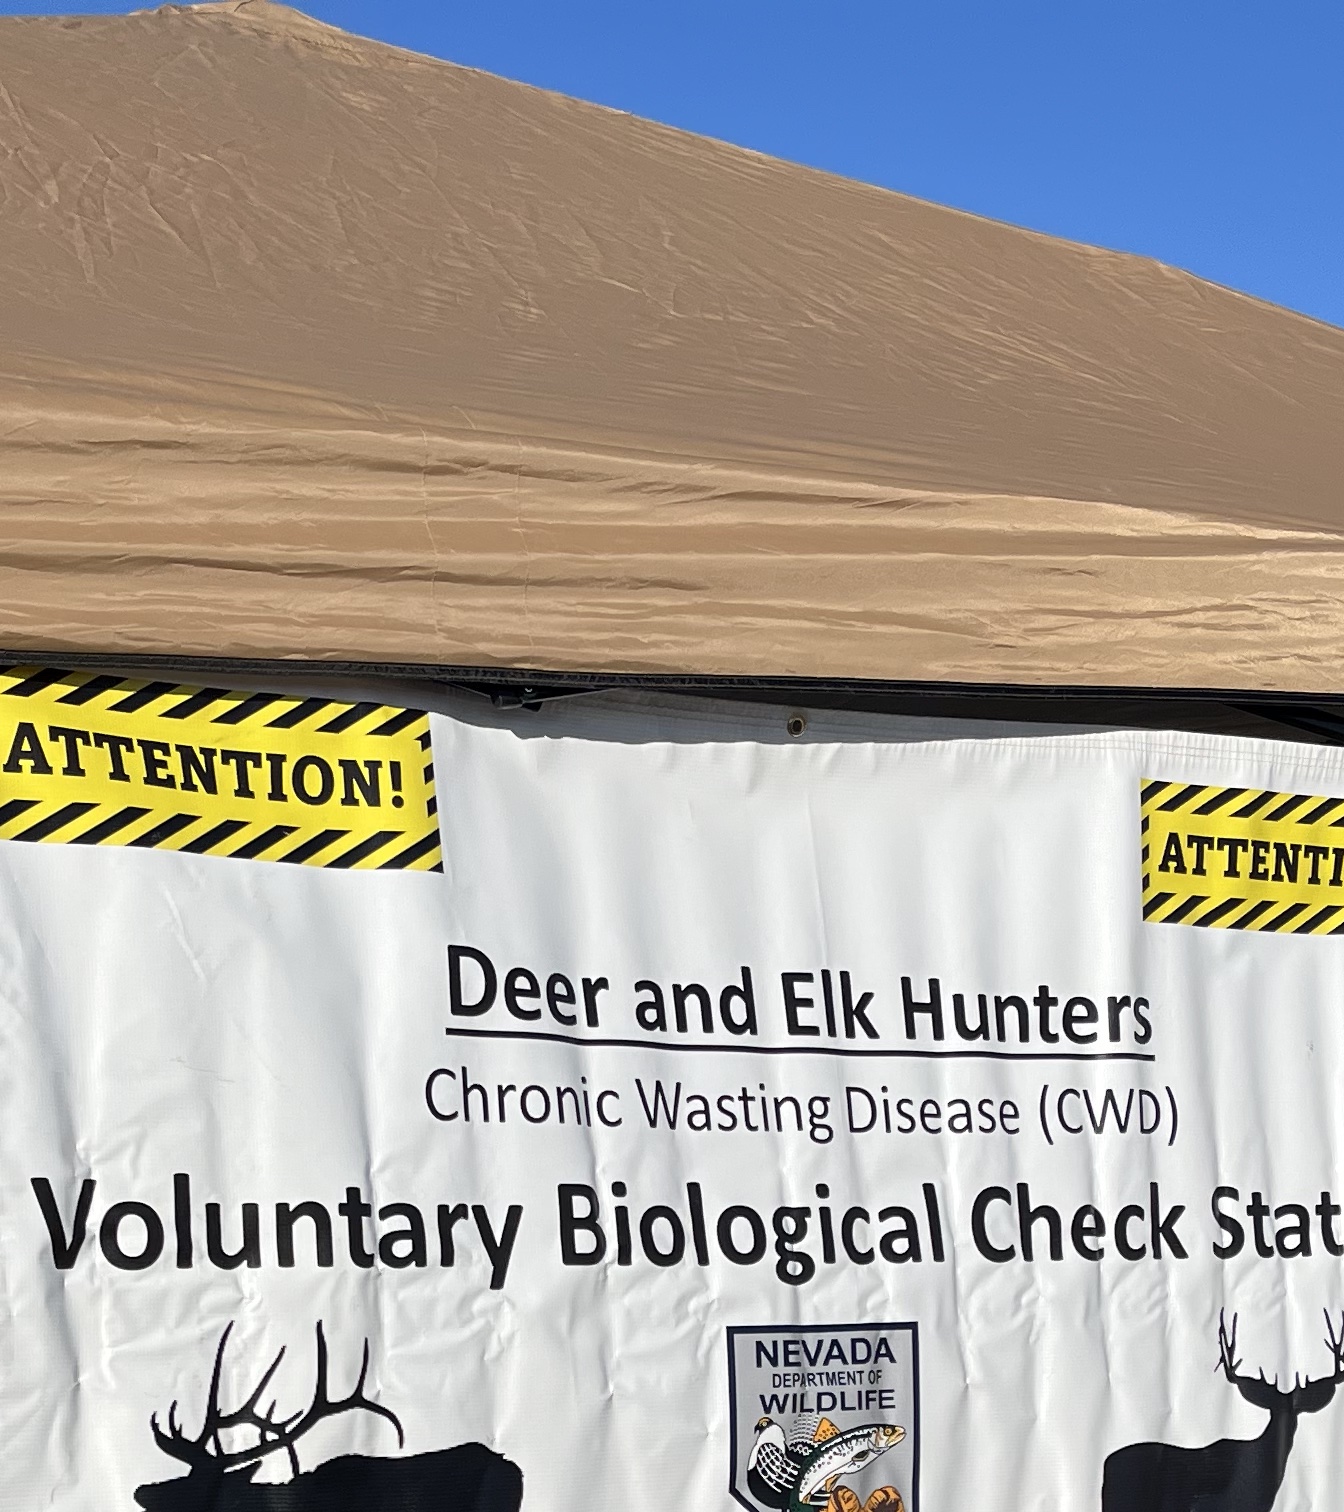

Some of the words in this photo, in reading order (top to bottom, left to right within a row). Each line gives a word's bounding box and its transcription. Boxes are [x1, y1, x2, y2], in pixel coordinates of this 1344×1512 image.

[2, 722, 405, 809] ATTENTION!
[447, 944, 610, 1028] Deer
[634, 965, 758, 1036] and
[781, 968, 881, 1040] Elk
[900, 976, 1153, 1045] Hunters
[425, 1065, 623, 1128] Chronic
[634, 1077, 834, 1145] Wasting
[845, 1085, 1020, 1135] Disease
[1039, 1083, 1178, 1147] (CWD)
[30, 1172, 524, 1290] Voluntary
[557, 1181, 946, 1286] Biological
[970, 1181, 1189, 1262] Check
[754, 1336, 897, 1369] NEVADA
[772, 1370, 864, 1389] DEPARTMENT
[868, 1369, 883, 1386] OF
[759, 1388, 896, 1415] WILDLIFE
